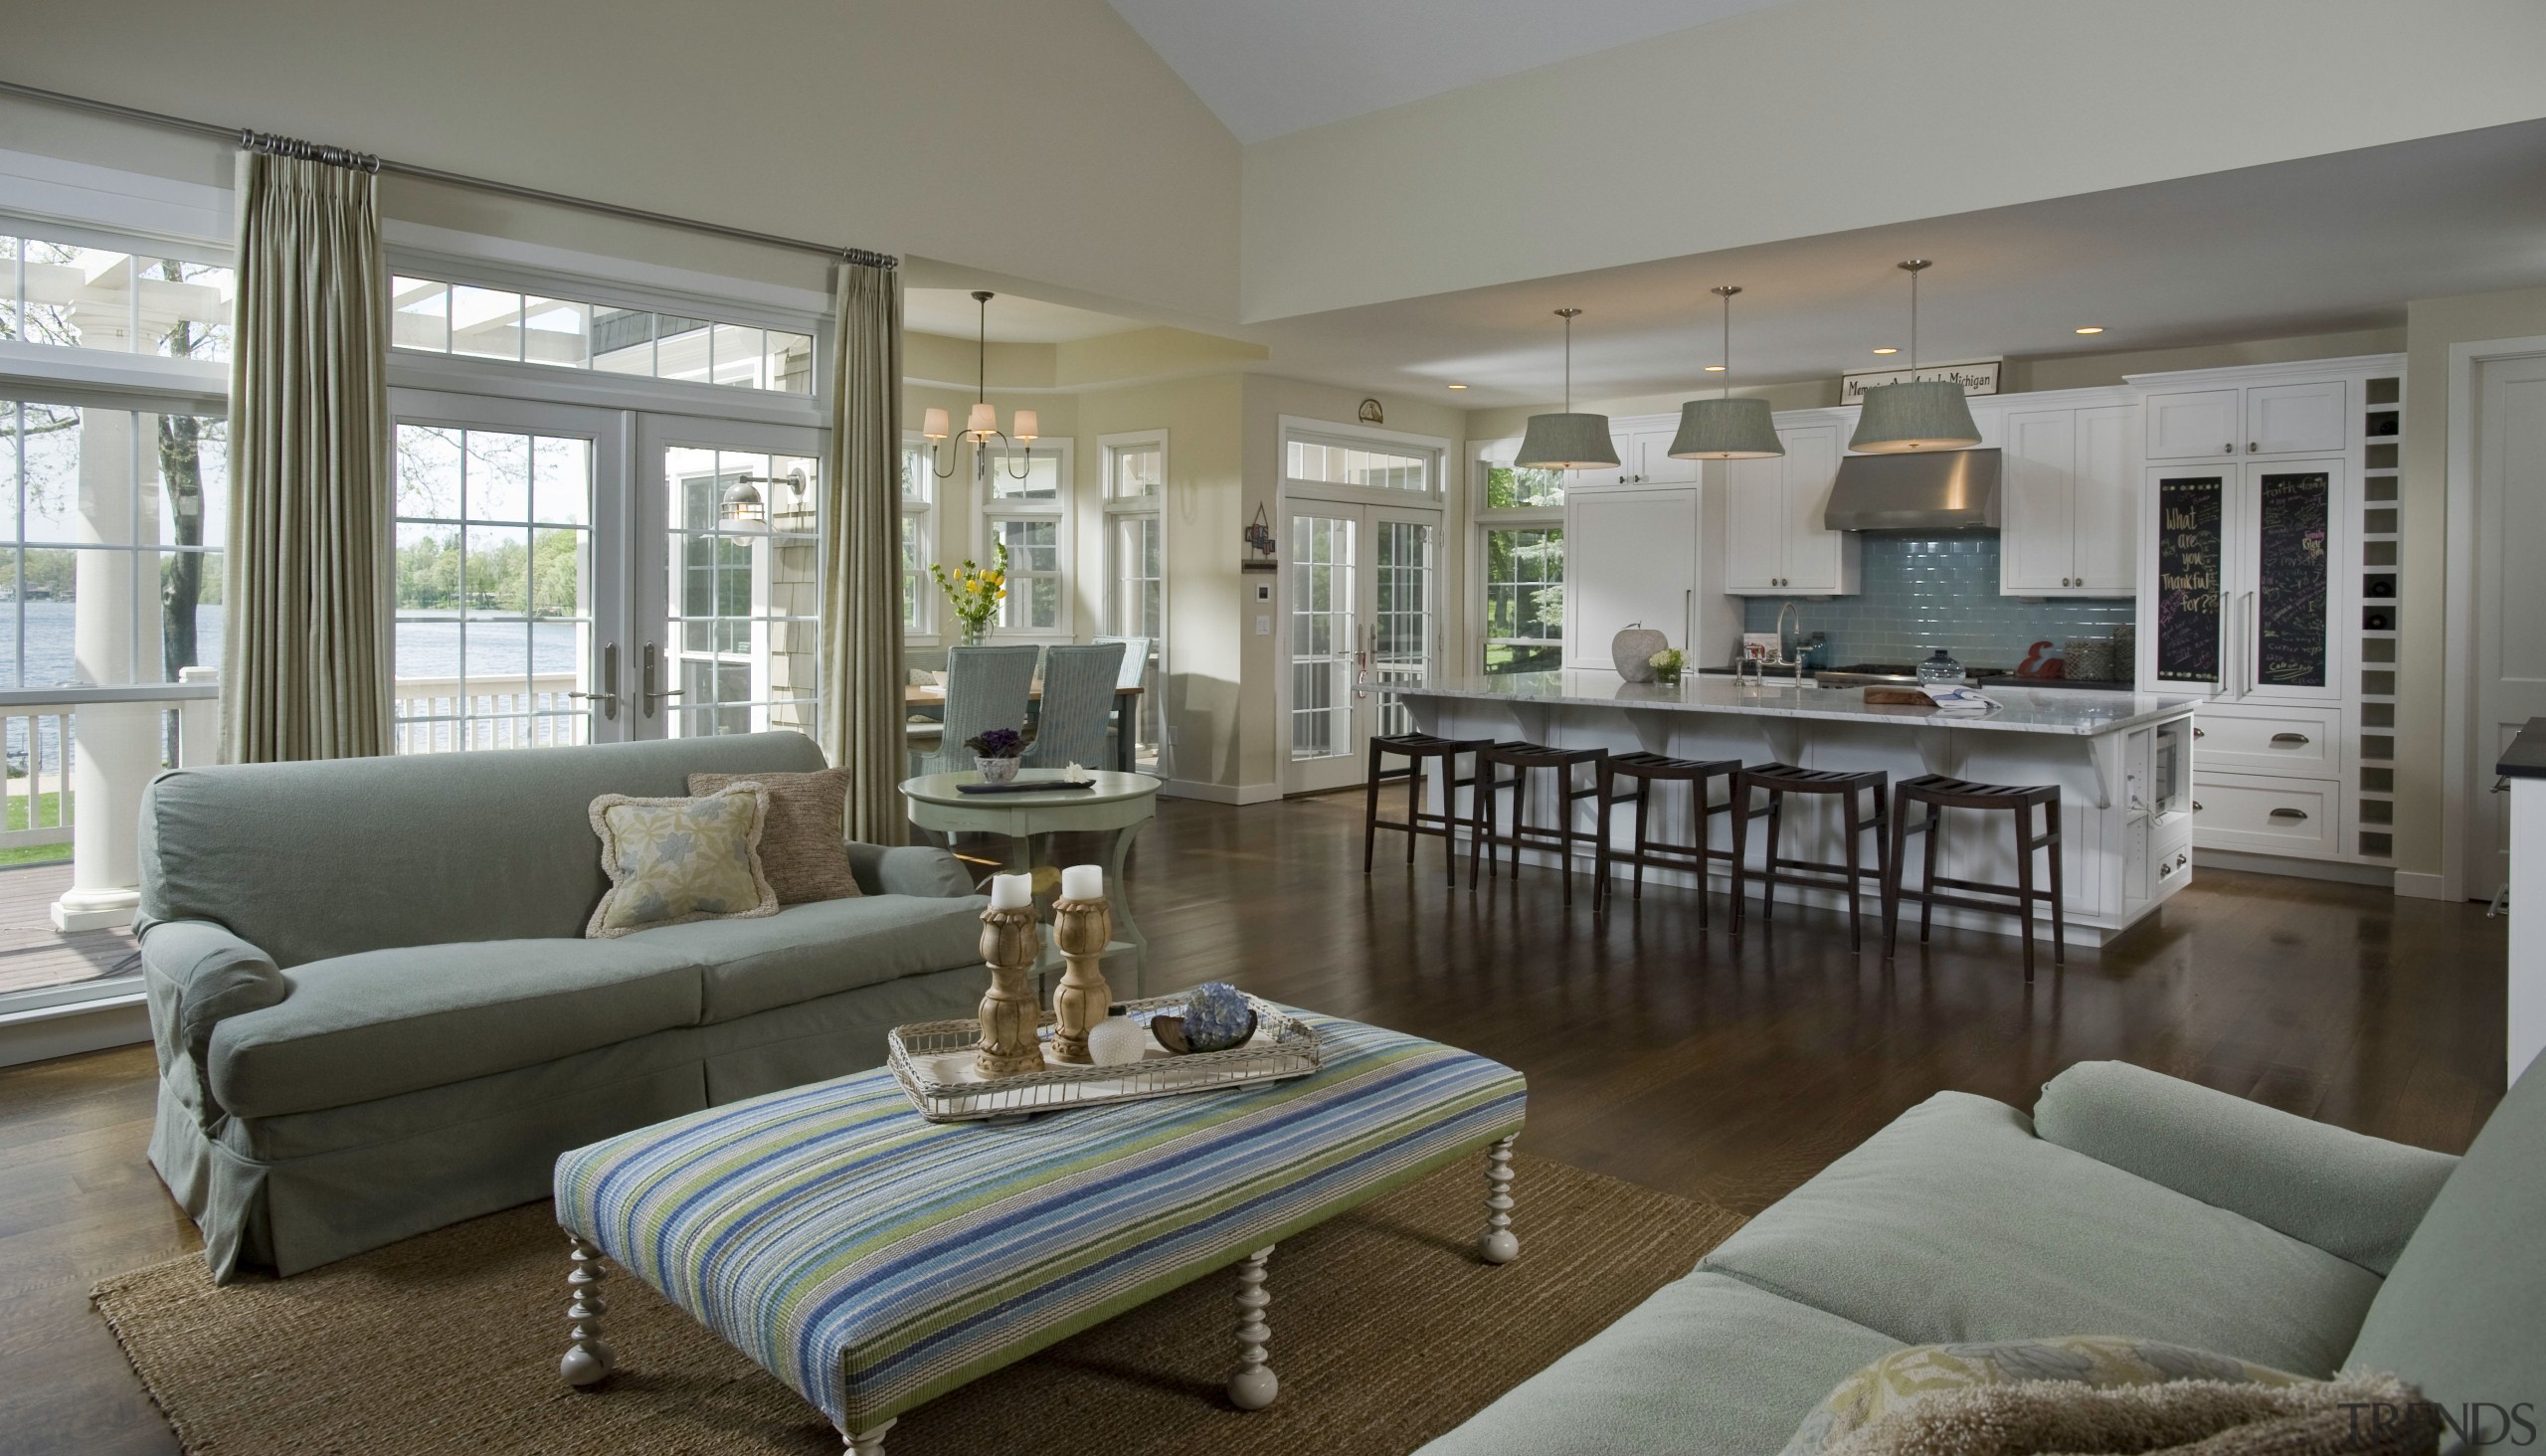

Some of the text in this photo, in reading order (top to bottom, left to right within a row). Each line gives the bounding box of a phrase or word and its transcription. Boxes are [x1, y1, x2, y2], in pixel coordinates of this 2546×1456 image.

[1950, 372, 1991, 390] Michigan
[2165, 505, 2197, 530] What
[2177, 534, 2197, 549] are
[2182, 552, 2202, 572] you
[2160, 572, 2211, 591] Thankful
[2180, 594, 2209, 615] for?
